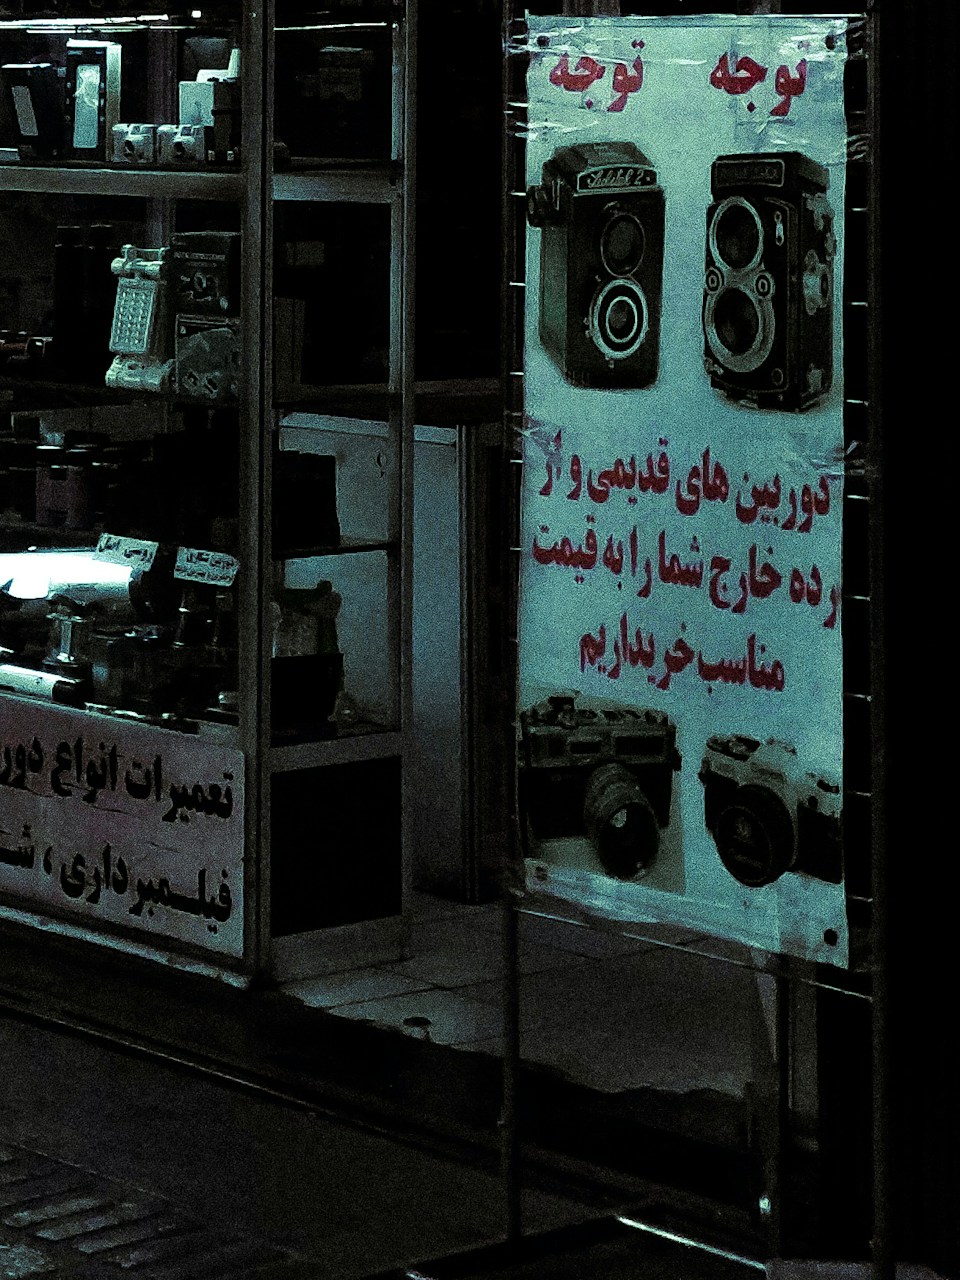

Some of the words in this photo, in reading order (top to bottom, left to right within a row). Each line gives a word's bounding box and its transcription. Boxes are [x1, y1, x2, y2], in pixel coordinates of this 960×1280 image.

[549, 39, 645, 113] توجه
[709, 40, 808, 118] توجه
[566, 453, 582, 501] و
[587, 436, 671, 504] قدیمی
[675, 445, 731, 516] های
[735, 472, 831, 533] دوربین
[532, 514, 598, 585] قیمت
[602, 535, 624, 591] به
[630, 525, 653, 598] را
[658, 529, 705, 589] شما
[708, 542, 783, 615] خارج
[579, 613, 695, 692] خریداریم
[697, 633, 786, 696] مناسب
[49, 736, 118, 804] انواع
[124, 750, 235, 823] تعمیرات
